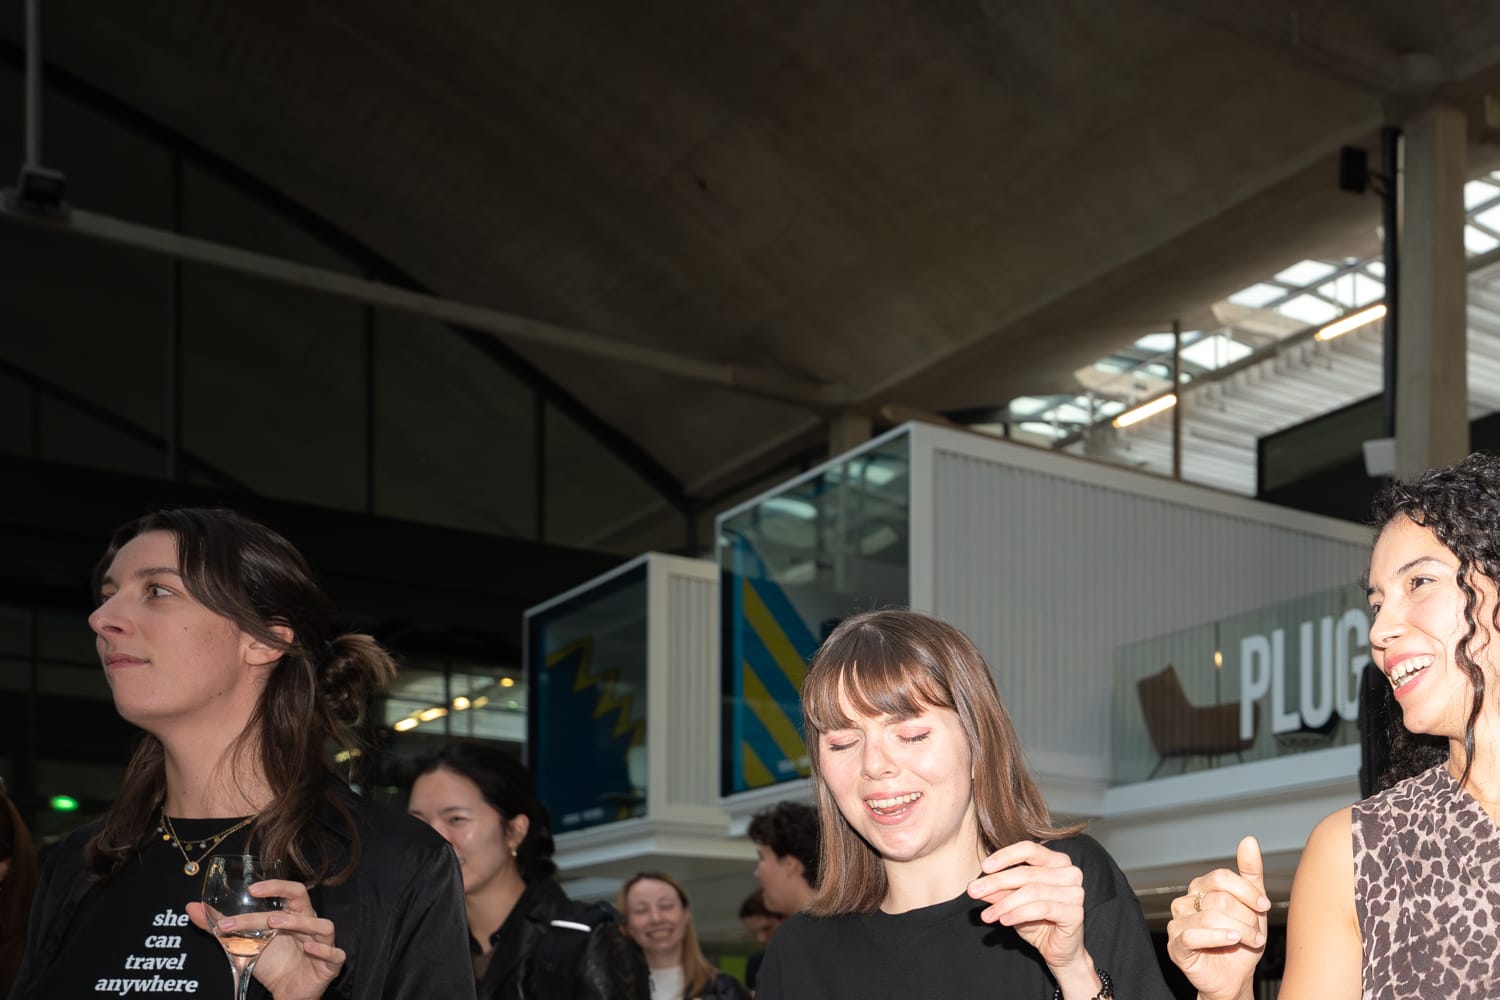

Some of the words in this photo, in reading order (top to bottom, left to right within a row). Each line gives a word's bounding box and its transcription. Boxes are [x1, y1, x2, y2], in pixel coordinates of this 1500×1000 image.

[1240, 608, 1370, 741] PLUG
[153, 909, 189, 927] she
[145, 935, 182, 949] can
[125, 953, 187, 971] travel
[95, 975, 199, 996] anywhere
